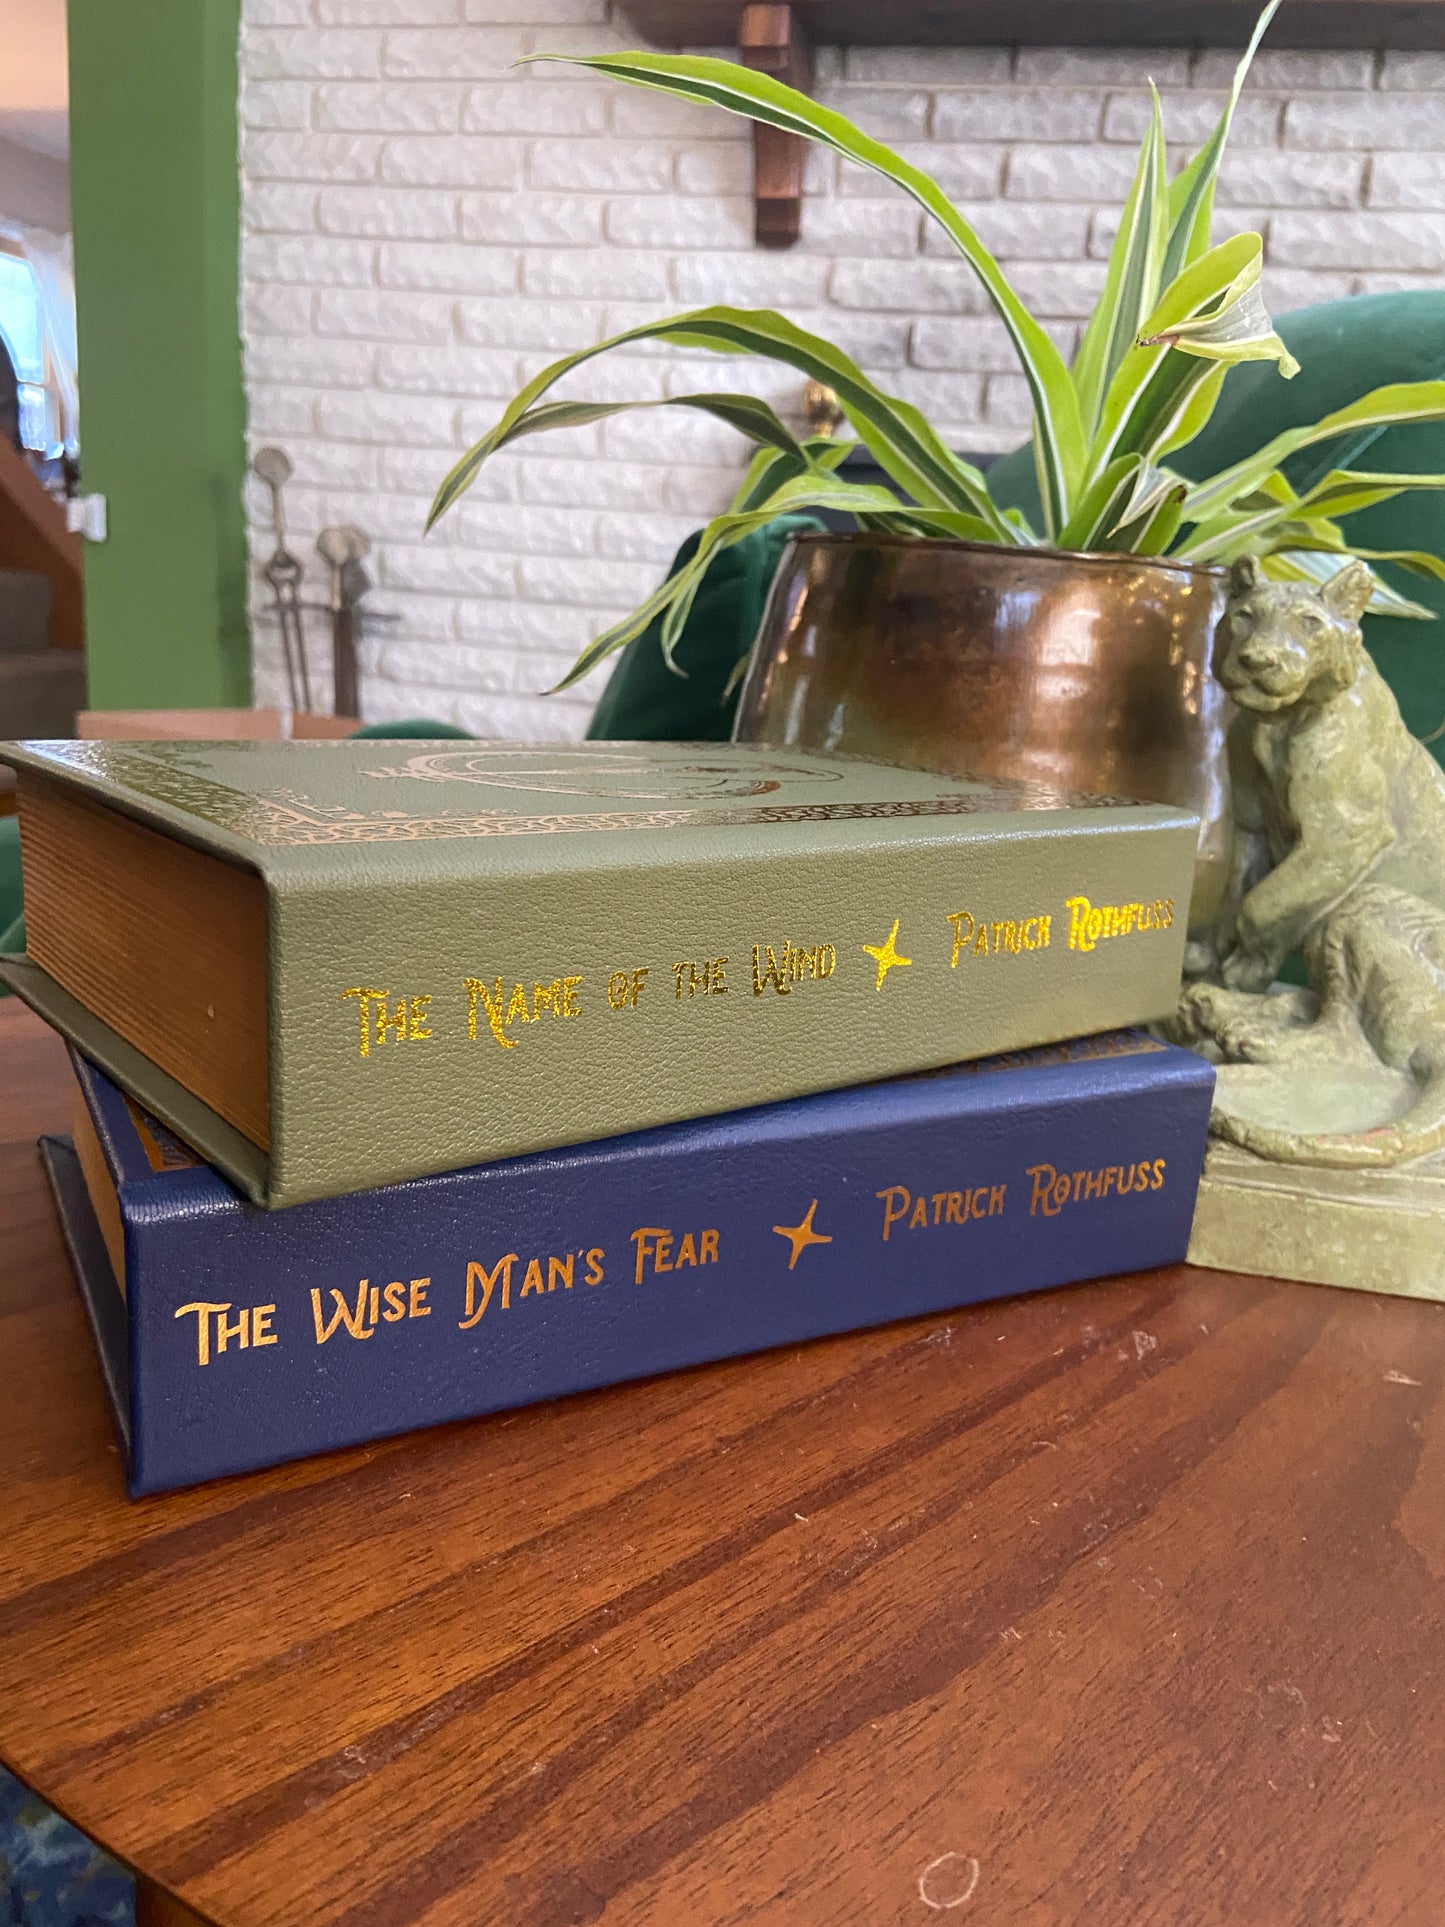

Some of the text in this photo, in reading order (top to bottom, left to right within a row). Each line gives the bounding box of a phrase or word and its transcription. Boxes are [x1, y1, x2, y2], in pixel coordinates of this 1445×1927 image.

[341, 896, 1173, 1057] THE NAME OF THE WIND PATRICK ROTHFUSS
[174, 1159, 1166, 1366] THE WISE MAN'S FEAR PATRICK ROTHFUSS
